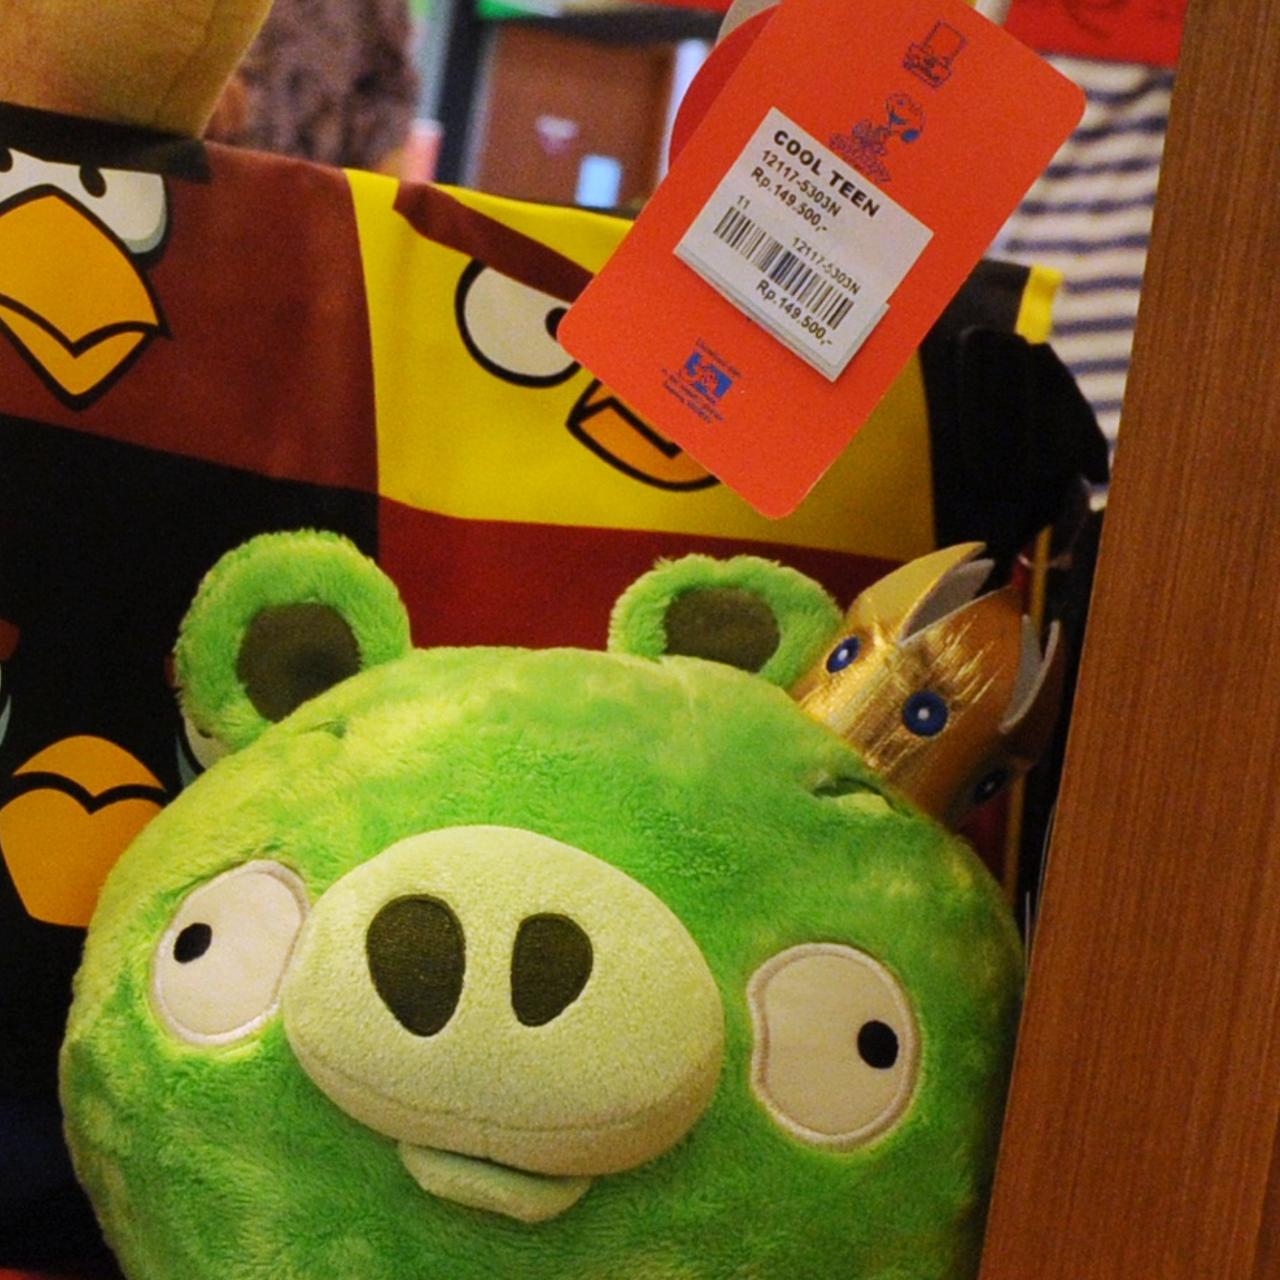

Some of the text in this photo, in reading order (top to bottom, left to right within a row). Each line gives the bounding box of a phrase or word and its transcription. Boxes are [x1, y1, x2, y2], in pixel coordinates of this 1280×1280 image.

[761, 150, 842, 218] 12117-5303N
[773, 129, 824, 176] COOL
[828, 170, 881, 218] TEEN
